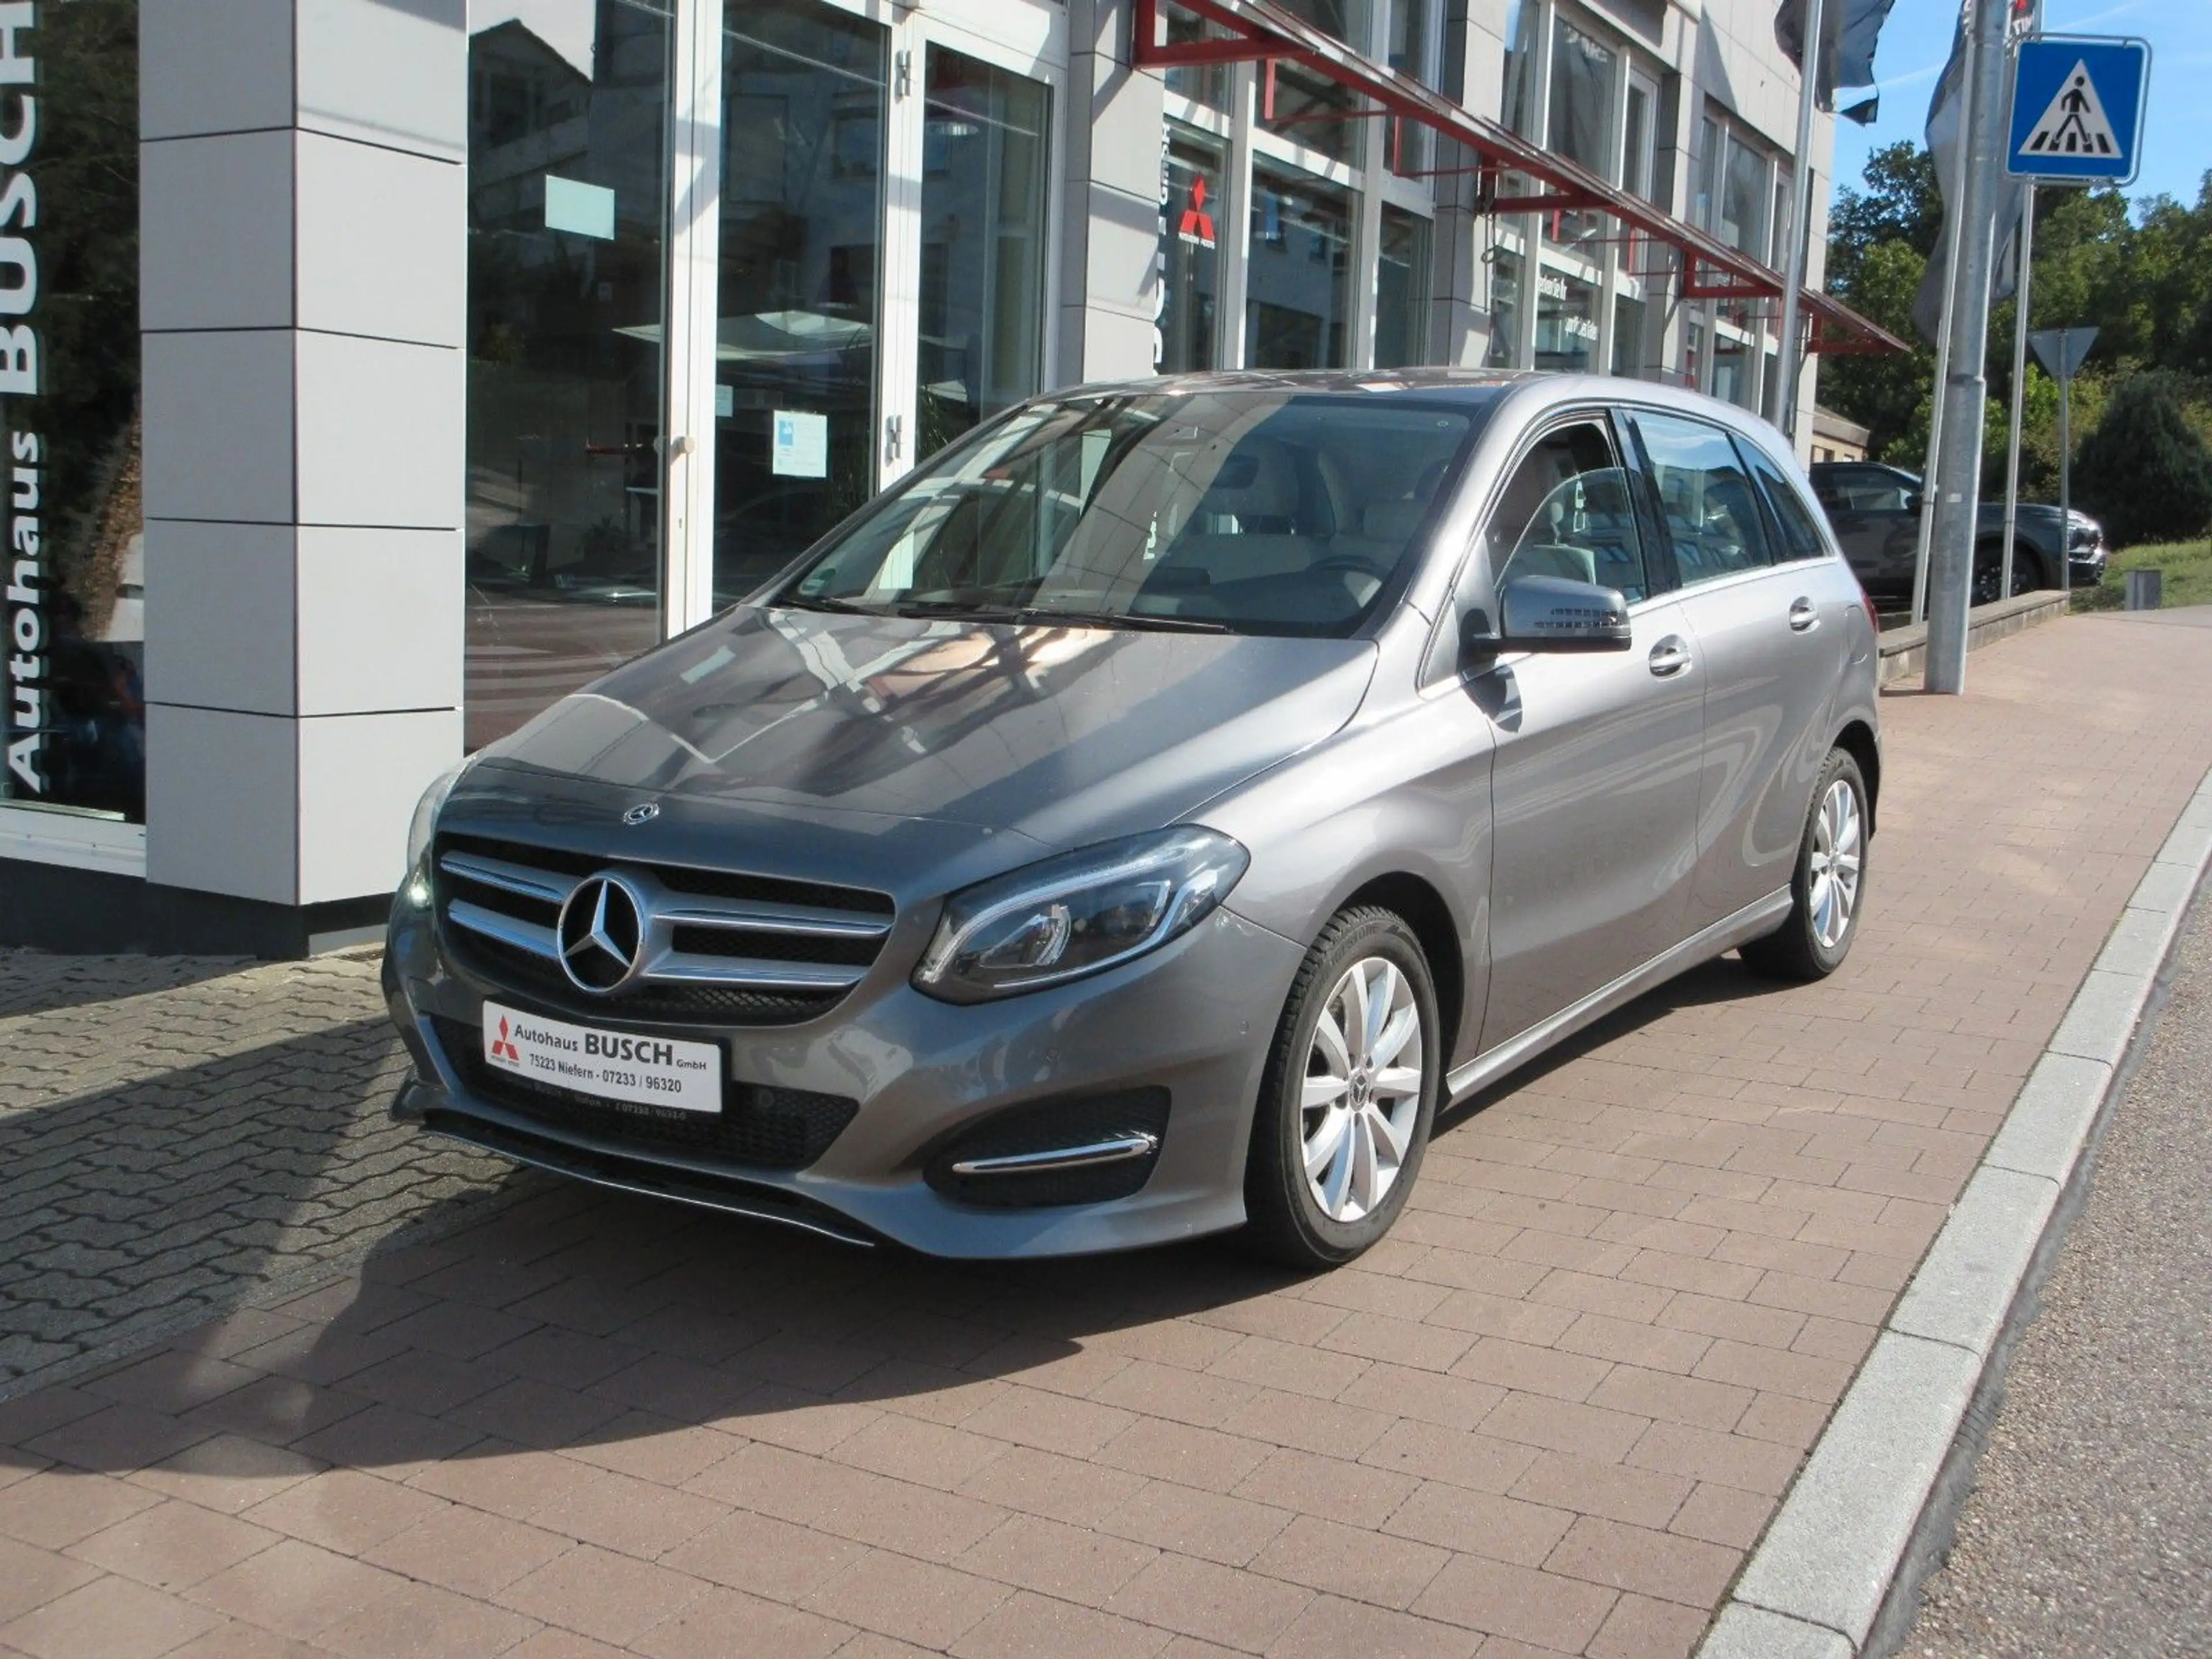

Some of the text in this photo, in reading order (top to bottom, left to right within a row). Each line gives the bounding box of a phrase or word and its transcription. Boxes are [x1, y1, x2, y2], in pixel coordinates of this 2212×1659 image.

[0, 2, 41, 794] Autohaus BUSCH
[514, 1024, 707, 1070] Autohaus BUSCH GmbH
[529, 1053, 555, 1071] 75223
[558, 1060, 593, 1080] Niefern
[603, 1069, 636, 1086] 07233
[645, 1075, 682, 1093] 96320
